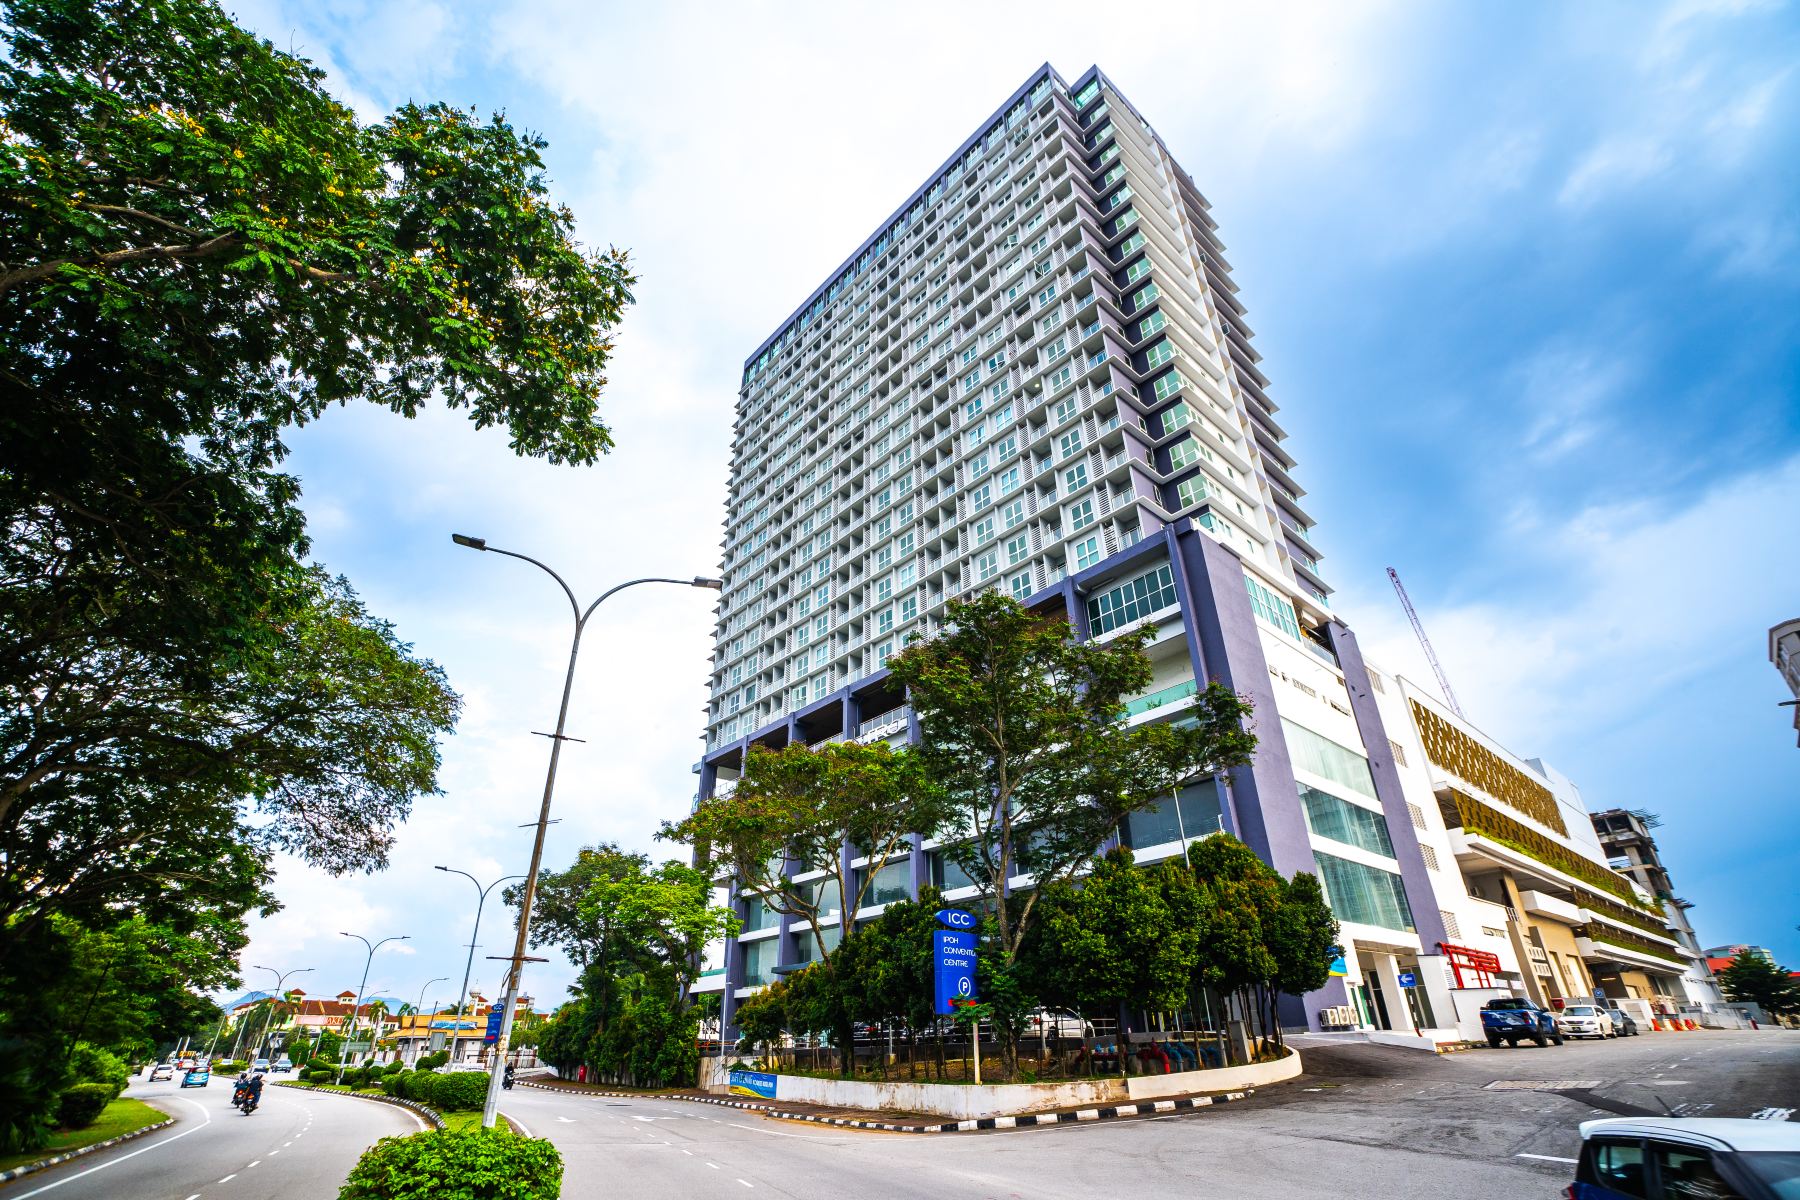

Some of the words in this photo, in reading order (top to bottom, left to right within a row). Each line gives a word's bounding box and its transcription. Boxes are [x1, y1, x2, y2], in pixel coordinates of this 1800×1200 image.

[948, 912, 970, 926] ICC
[943, 936, 959, 944] IPOH
[943, 958, 969, 968] CENTRE
[962, 981, 968, 991] P
